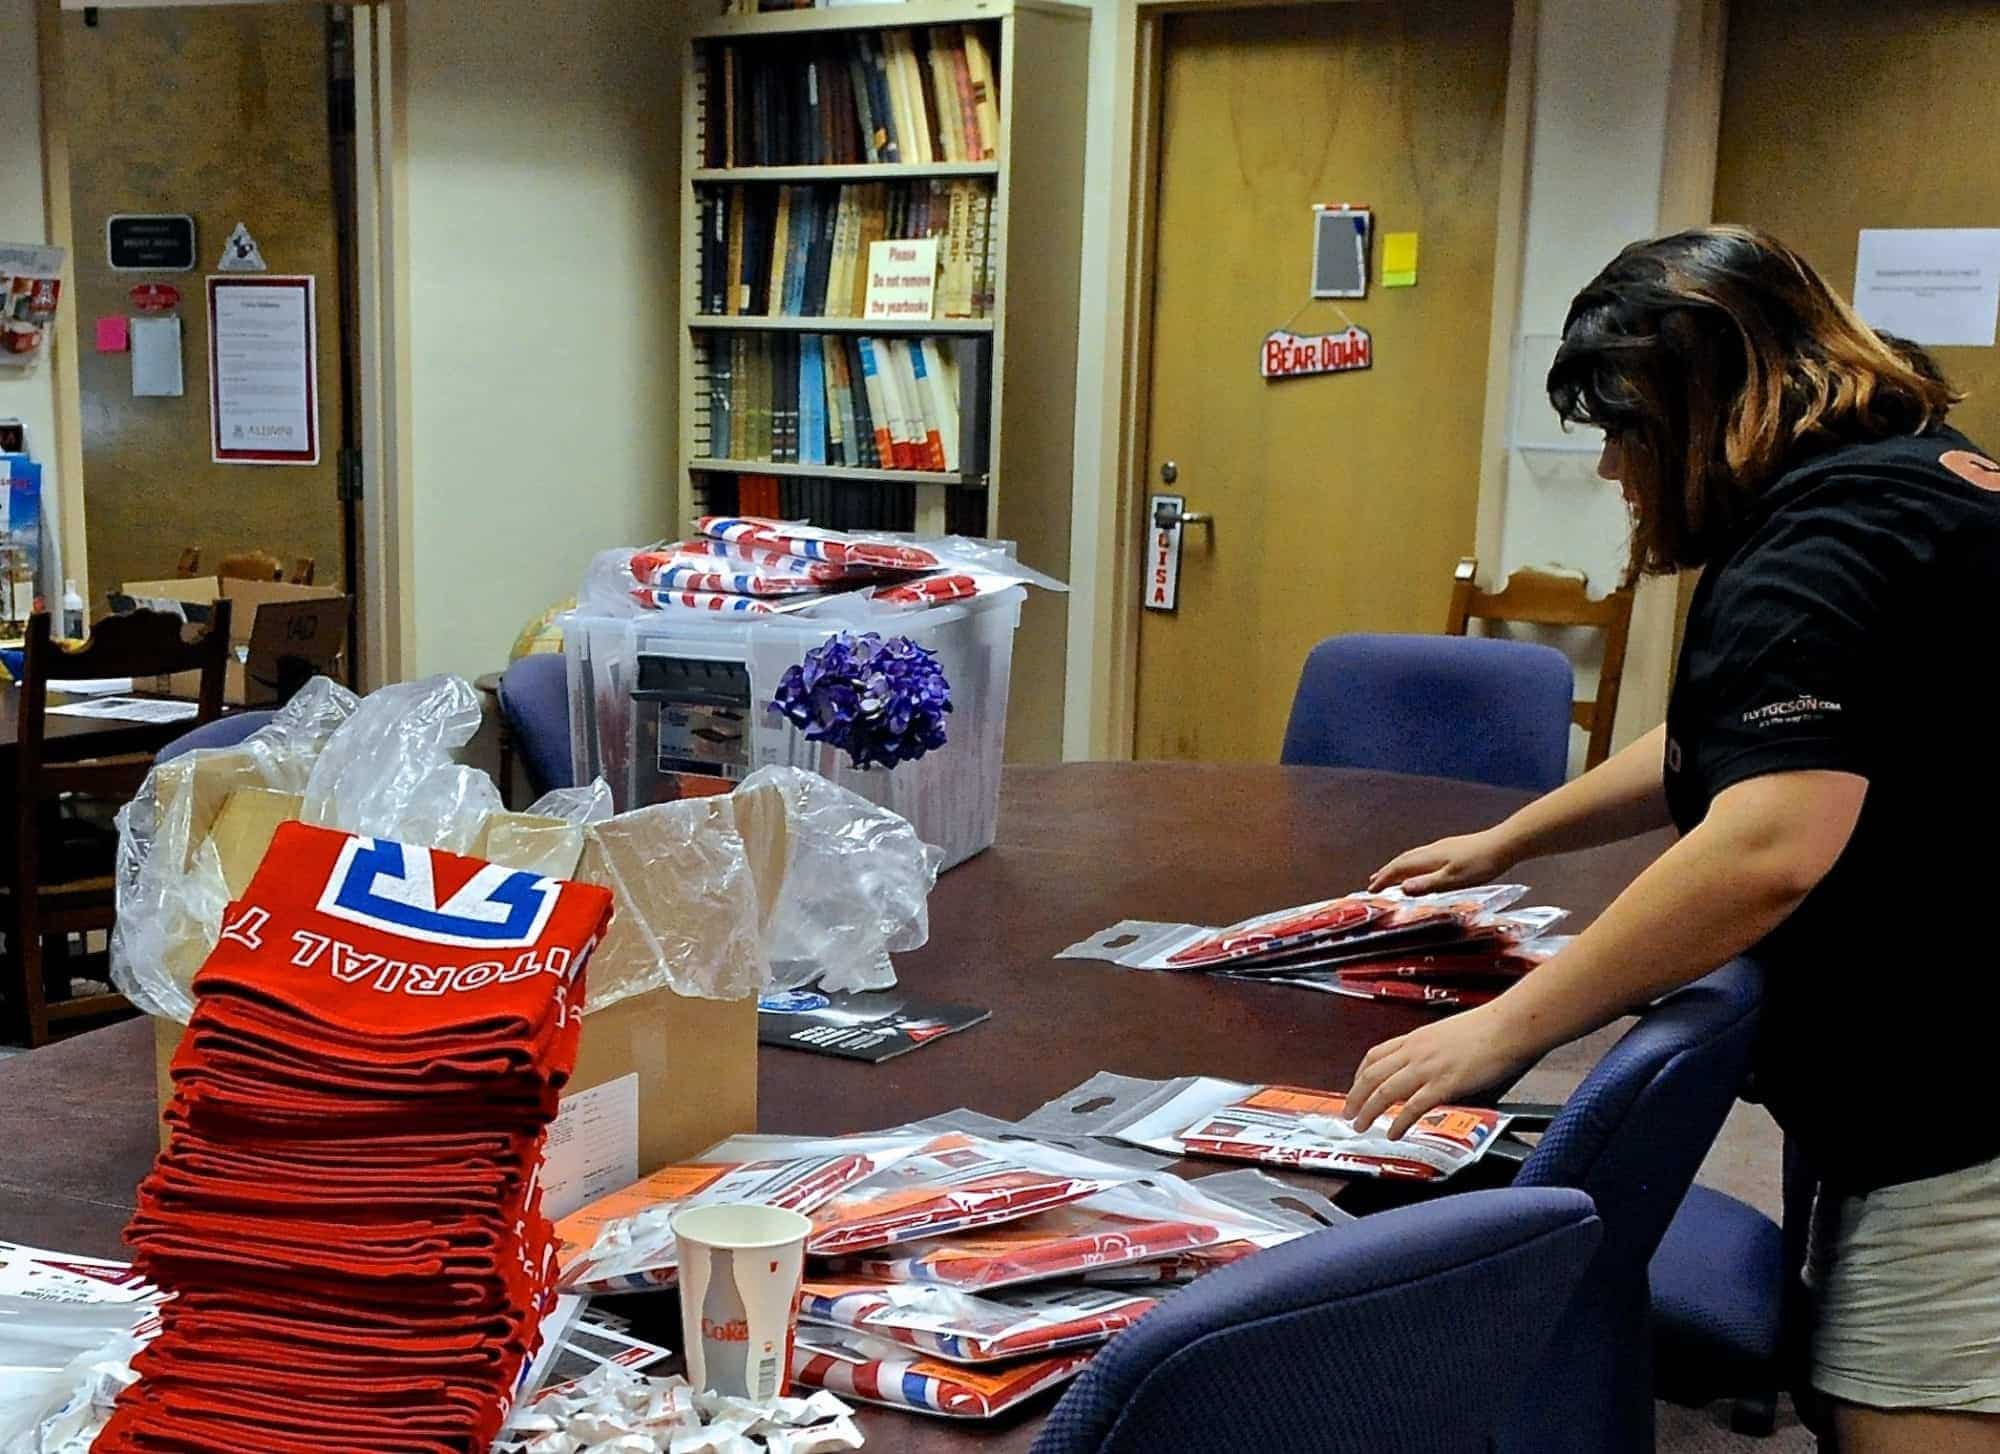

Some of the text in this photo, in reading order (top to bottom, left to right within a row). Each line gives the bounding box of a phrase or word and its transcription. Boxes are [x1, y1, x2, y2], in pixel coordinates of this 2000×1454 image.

[888, 246, 917, 262] Please
[873, 273, 931, 288] Do not remove
[871, 300, 929, 317] the yearbooks
[1266, 336, 1368, 374] BEAR DOWN
[701, 1317, 749, 1342] Coke
